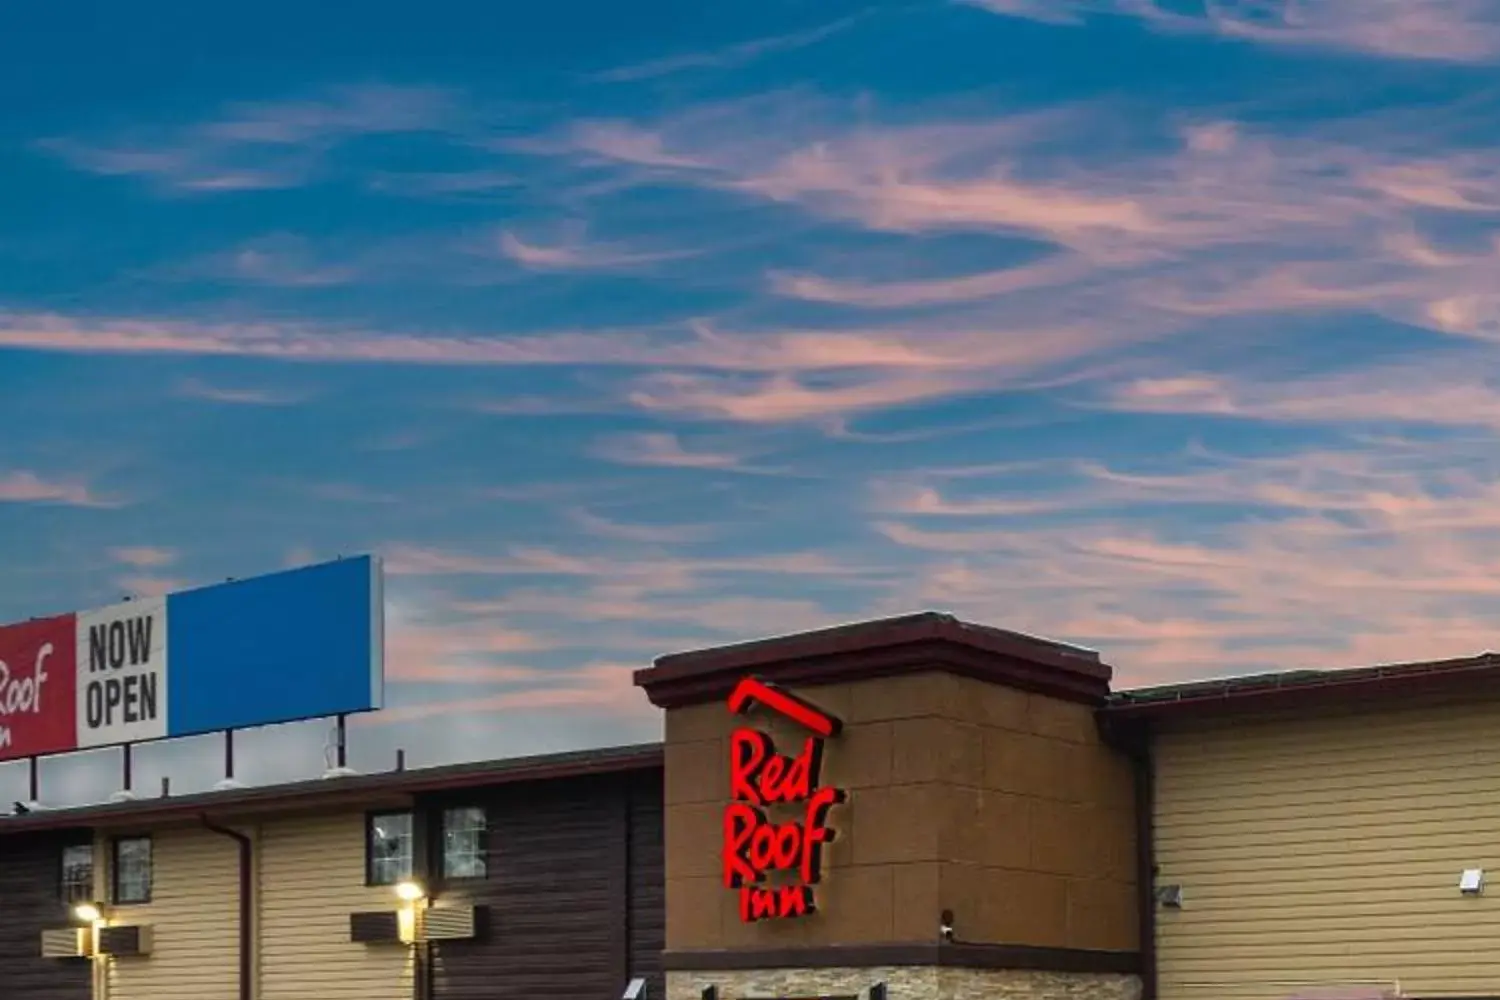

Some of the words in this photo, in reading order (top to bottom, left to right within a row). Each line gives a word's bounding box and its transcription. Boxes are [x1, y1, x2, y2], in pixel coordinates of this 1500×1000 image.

[89, 615, 153, 673] NOW
[86, 671, 157, 729] OPEN
[730, 728, 815, 806] Red
[721, 786, 838, 889] Roof
